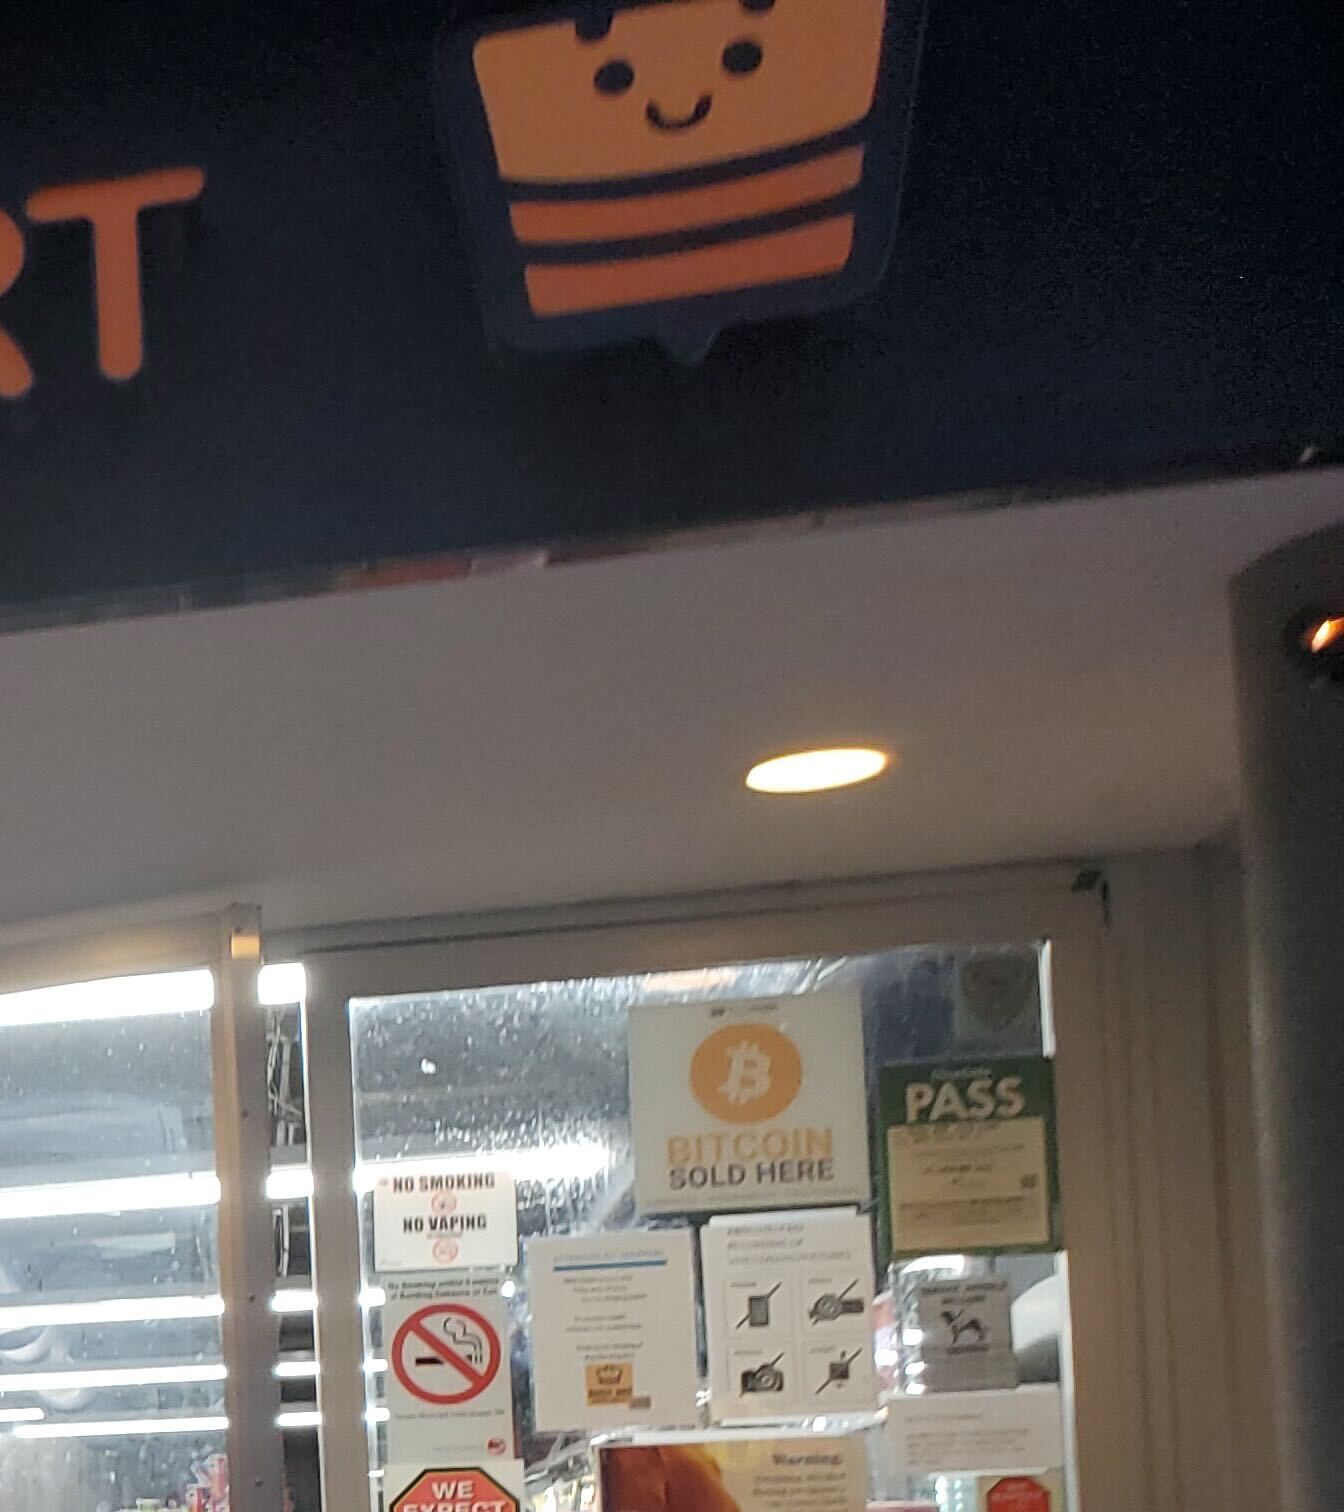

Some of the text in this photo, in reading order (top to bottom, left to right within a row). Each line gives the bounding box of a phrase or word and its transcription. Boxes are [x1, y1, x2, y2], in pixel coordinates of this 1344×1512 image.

[905, 1075, 1025, 1123] PASS
[667, 1128, 833, 1169] BITCOIN
[392, 1171, 496, 1193] NO SMOKING
[669, 1157, 835, 1190] SOLD HERE
[402, 1213, 488, 1234] NO VAPING
[431, 1481, 475, 1500] WE
